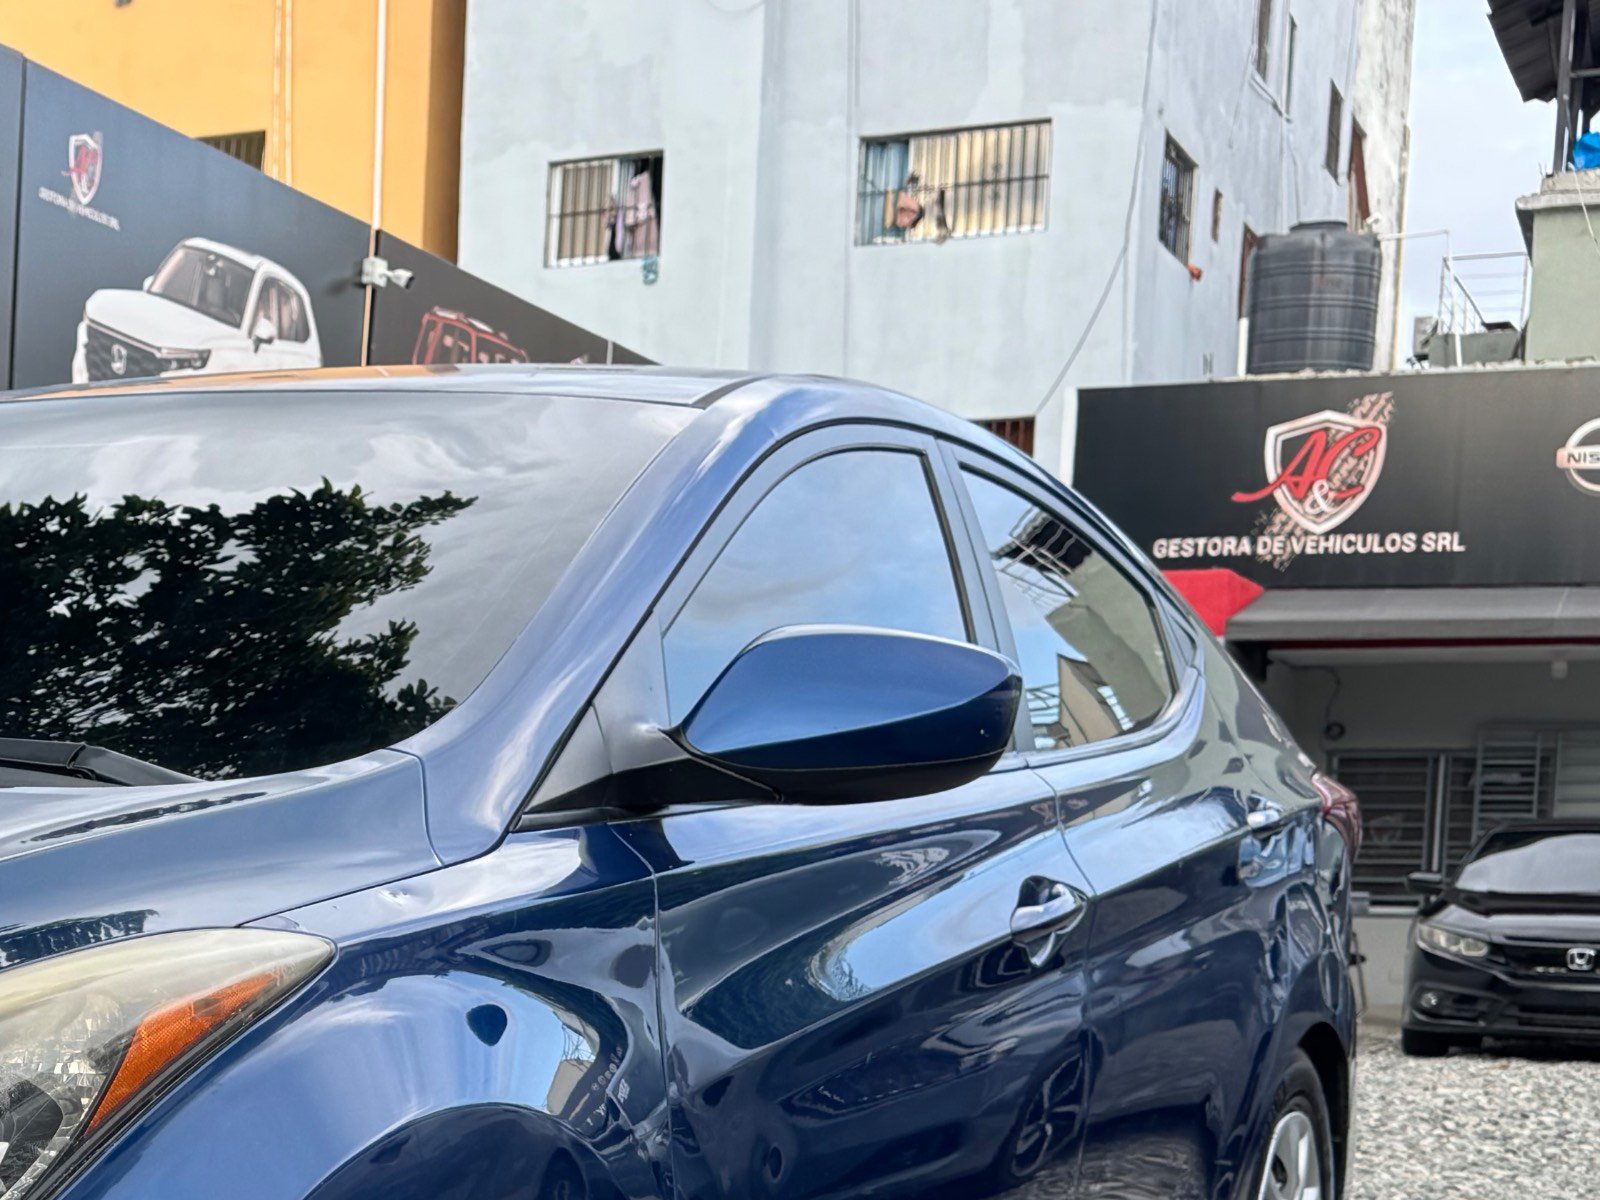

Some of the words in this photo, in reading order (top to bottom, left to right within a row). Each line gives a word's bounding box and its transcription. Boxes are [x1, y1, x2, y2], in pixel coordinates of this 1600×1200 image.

[1152, 536, 1250, 559] GESTORA
[1256, 535, 1287, 555] DE
[1288, 532, 1418, 556] VEHICULOS
[1420, 531, 1466, 553] SRL
